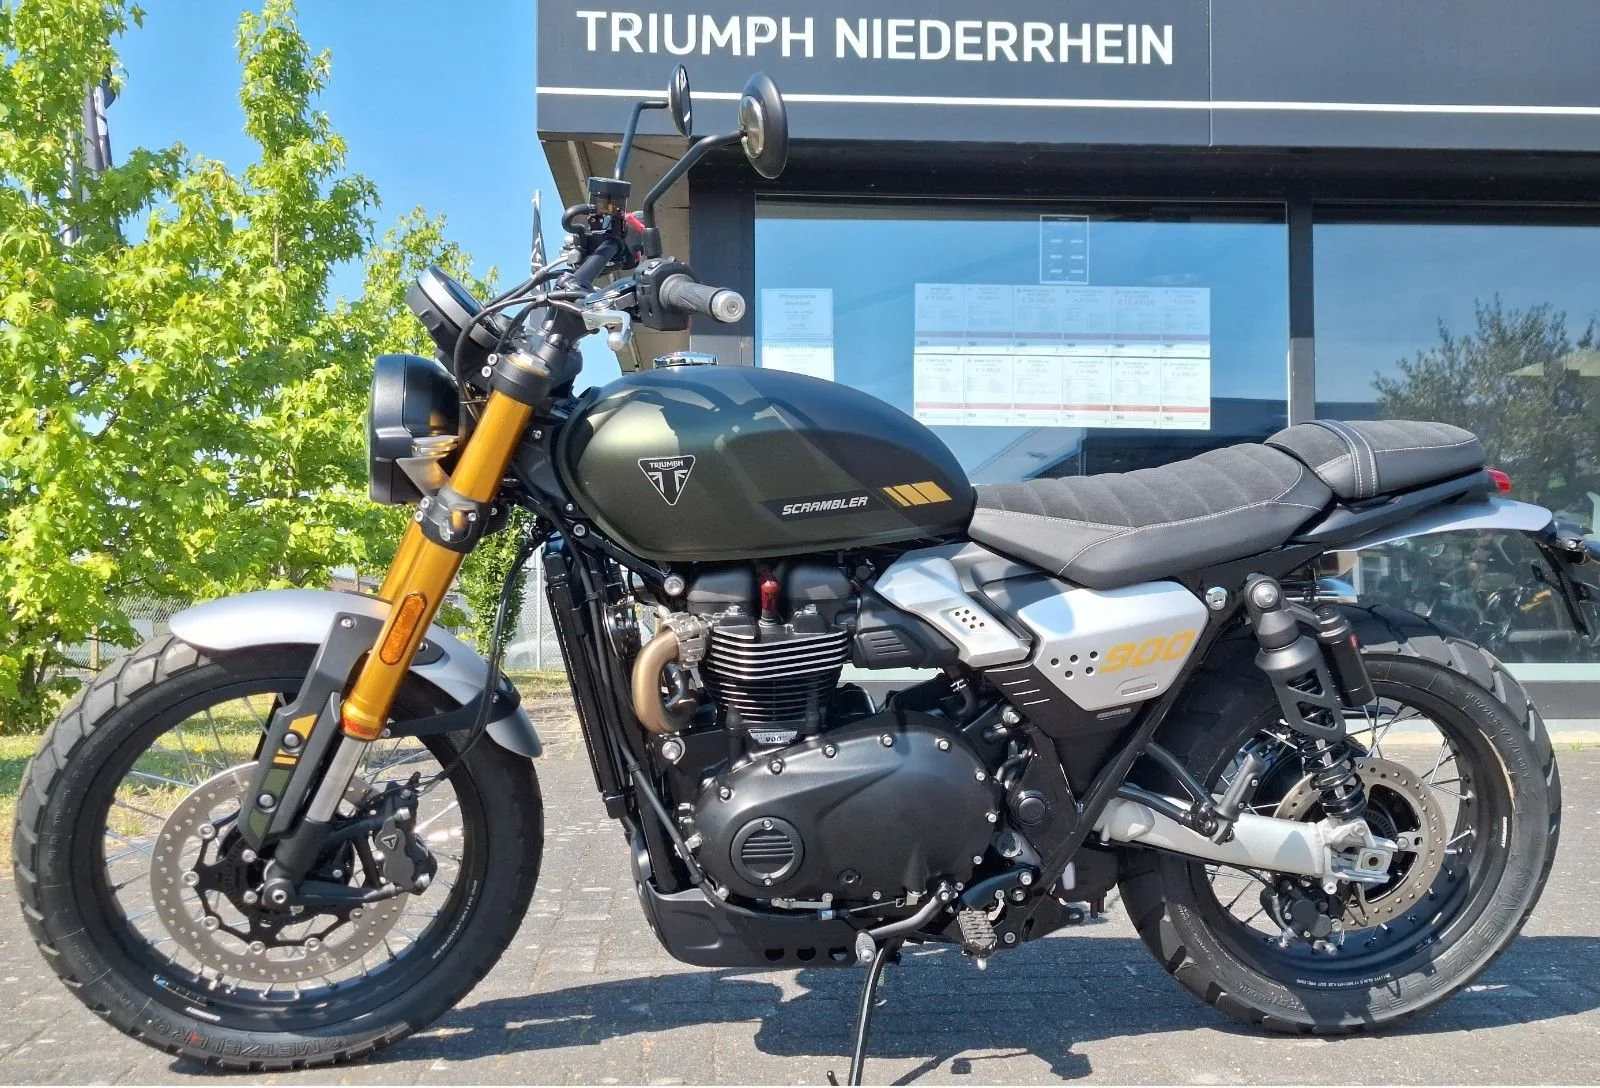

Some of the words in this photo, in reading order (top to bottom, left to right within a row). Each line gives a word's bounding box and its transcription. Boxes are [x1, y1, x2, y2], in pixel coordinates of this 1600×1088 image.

[576, 10, 814, 58] TRIUMPH
[835, 18, 1174, 65] NIEDERRHEIN
[649, 460, 684, 469] TRIUMPH
[781, 496, 868, 515] SCRAMBLER
[1100, 630, 1196, 673] 900
